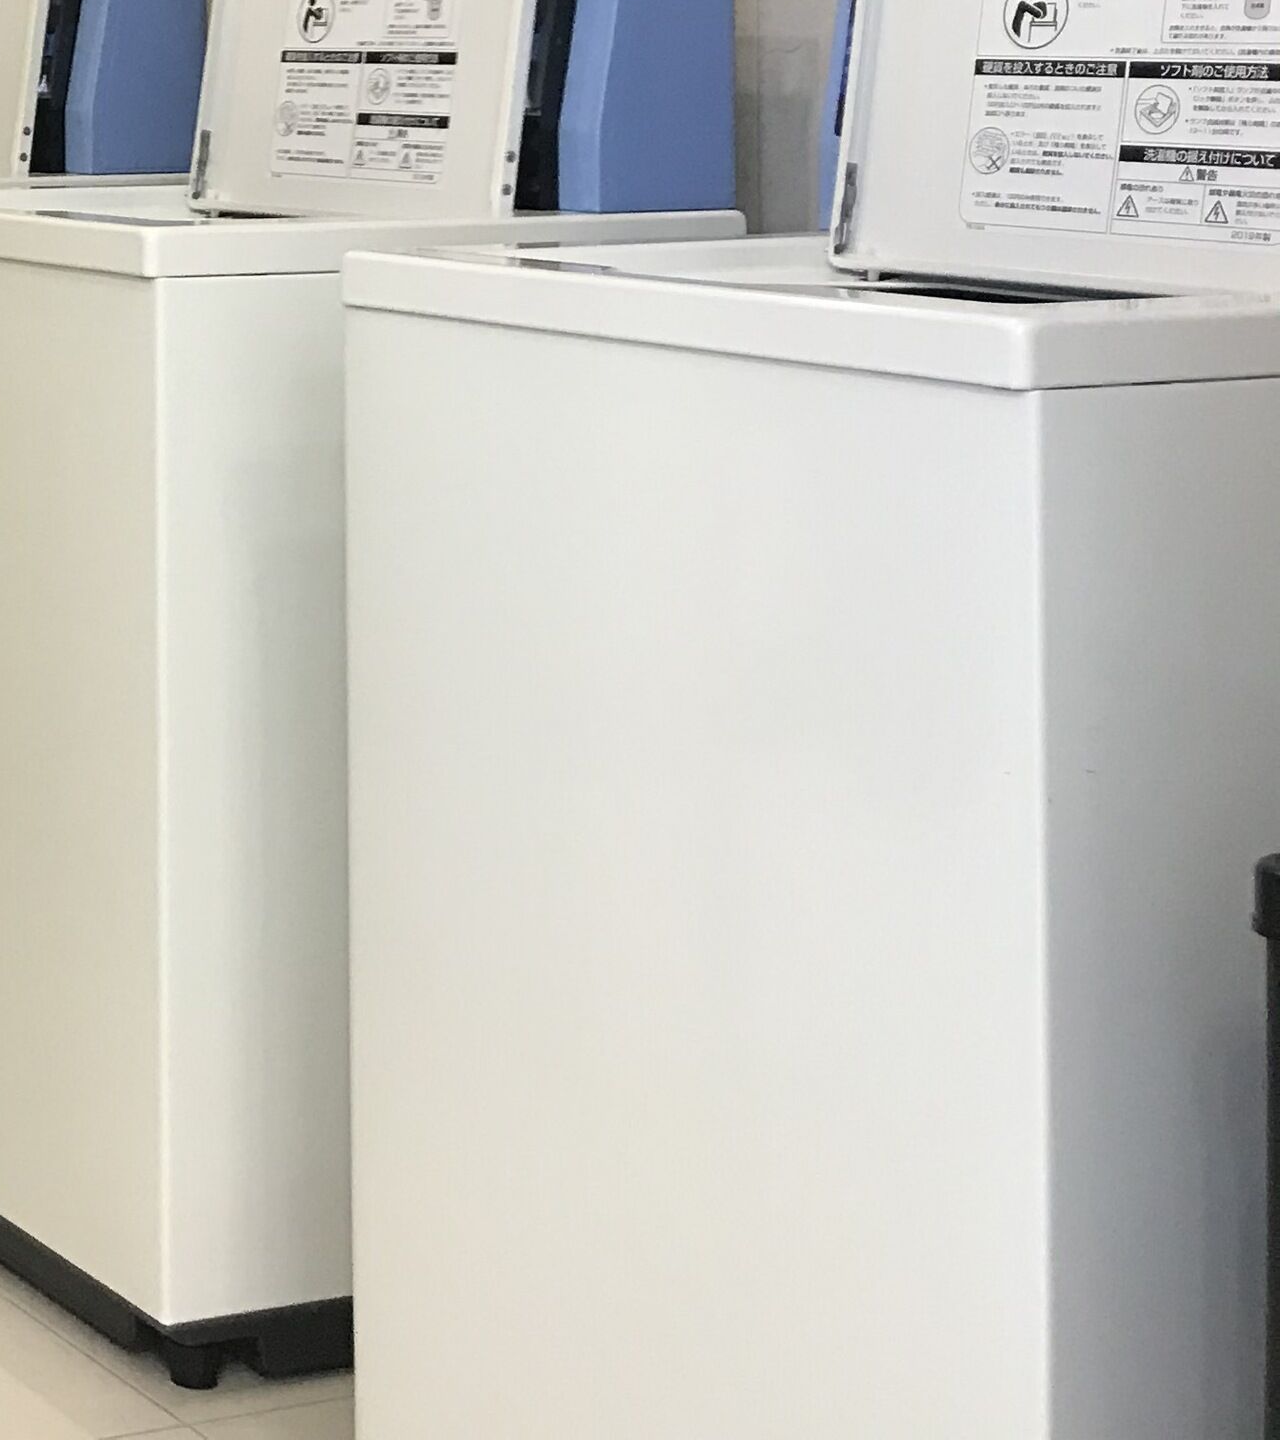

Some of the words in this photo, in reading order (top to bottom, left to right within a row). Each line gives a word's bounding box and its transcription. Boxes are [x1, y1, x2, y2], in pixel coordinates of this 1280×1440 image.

[982, 60, 1118, 77] 硬貨を投入するときのご注意
[1160, 64, 1270, 80] ソフト剤のご使用方法
[1142, 147, 1277, 168] 洗濯機の据え付けについて
[1196, 167, 1218, 182] 警告
